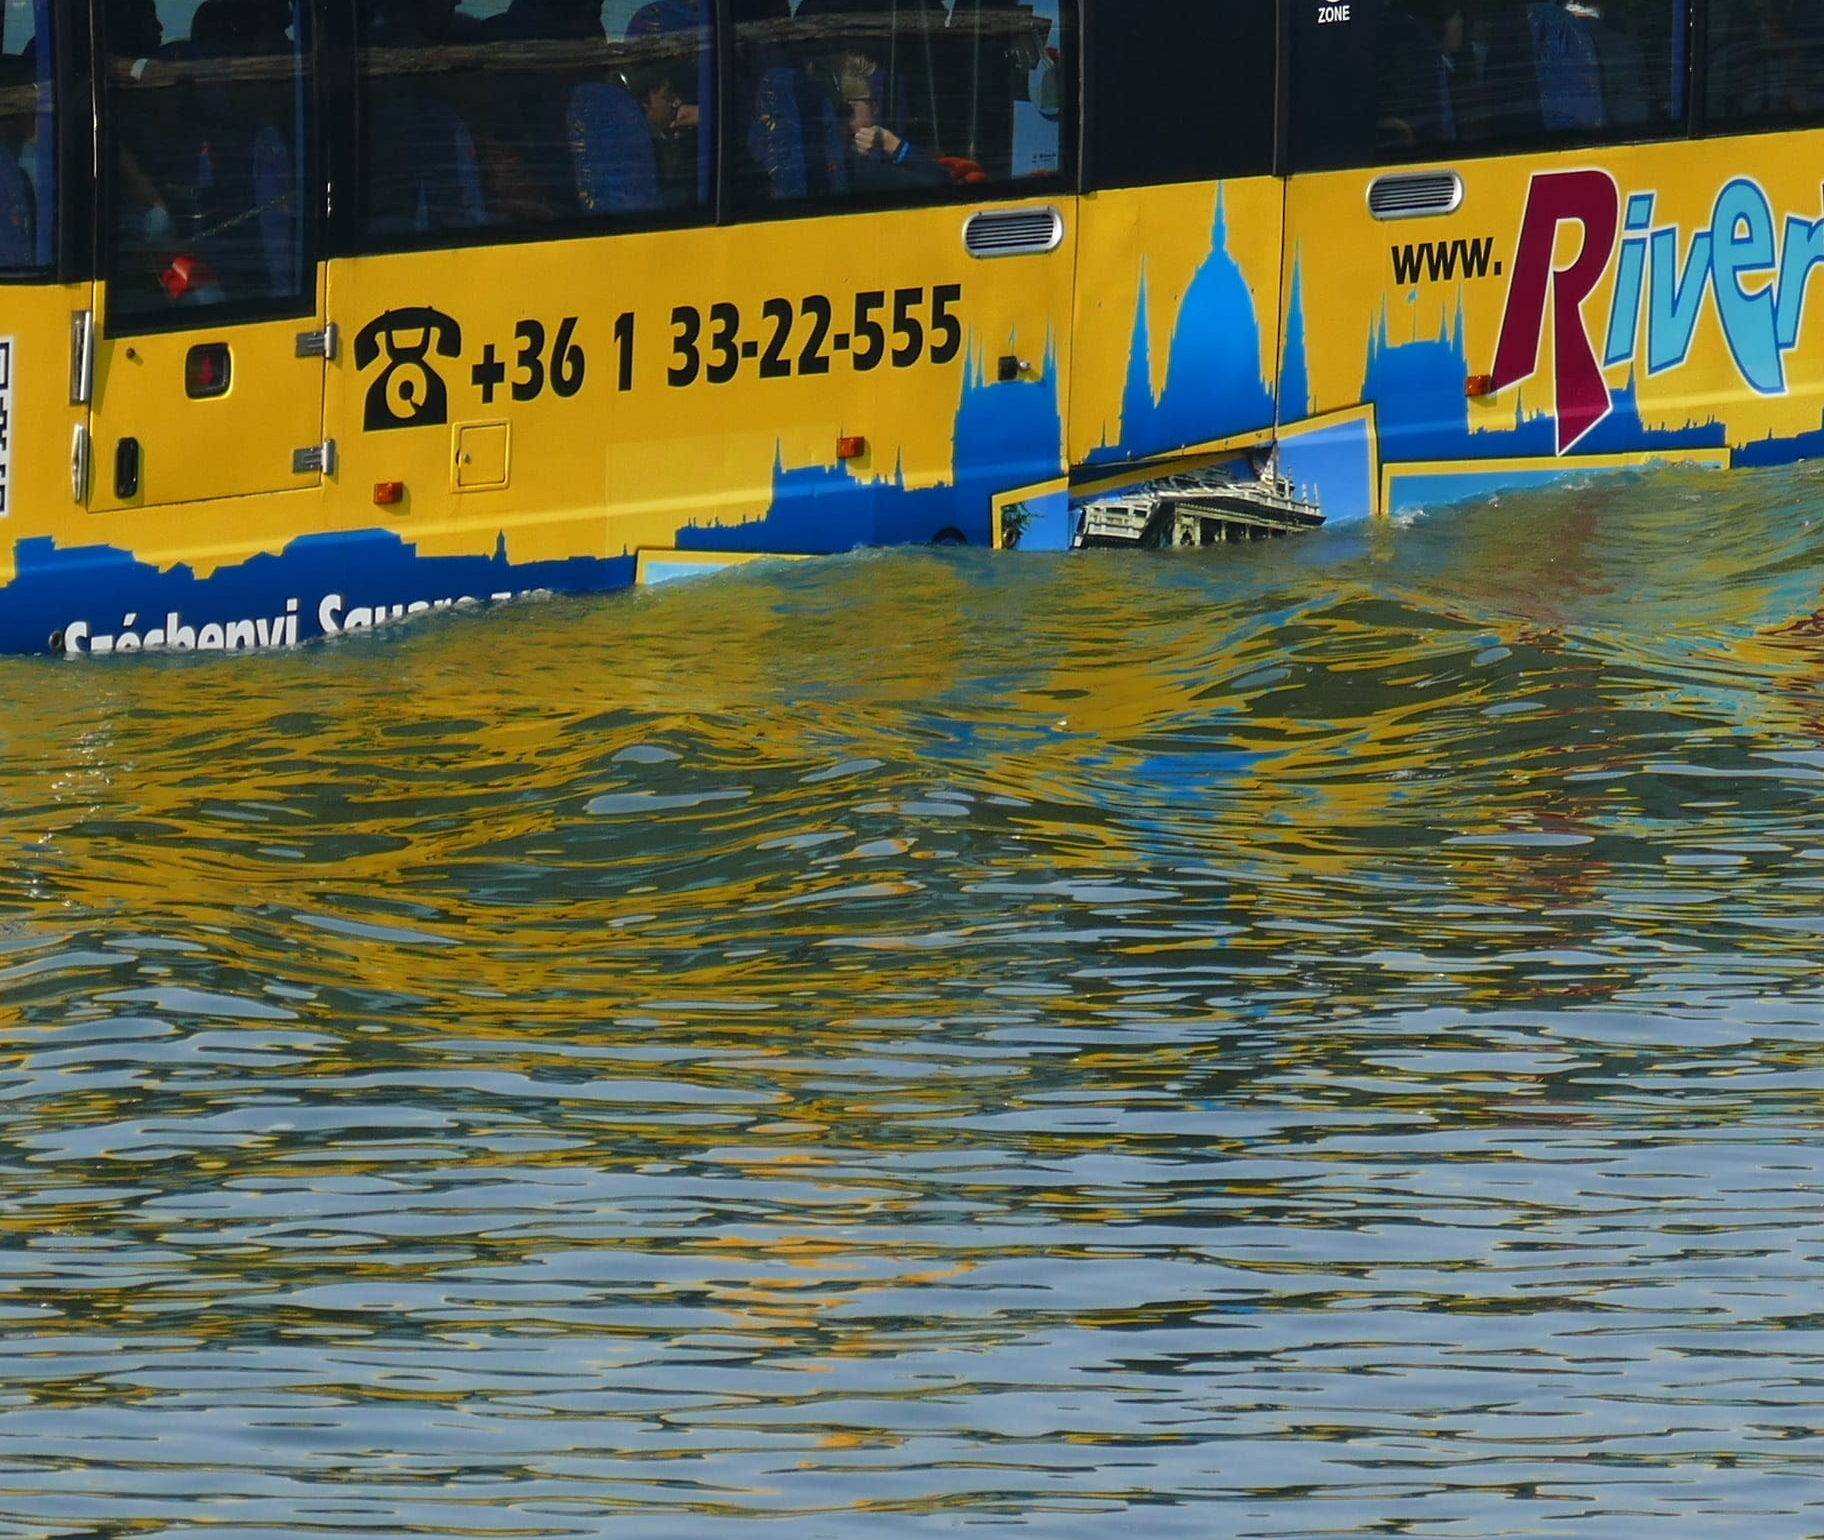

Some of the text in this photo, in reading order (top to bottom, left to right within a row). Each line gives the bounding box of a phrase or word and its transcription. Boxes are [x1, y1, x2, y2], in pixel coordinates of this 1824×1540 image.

[1317, 5, 1351, 24] ZONE
[470, 283, 962, 405] +36 1 33-22-555
